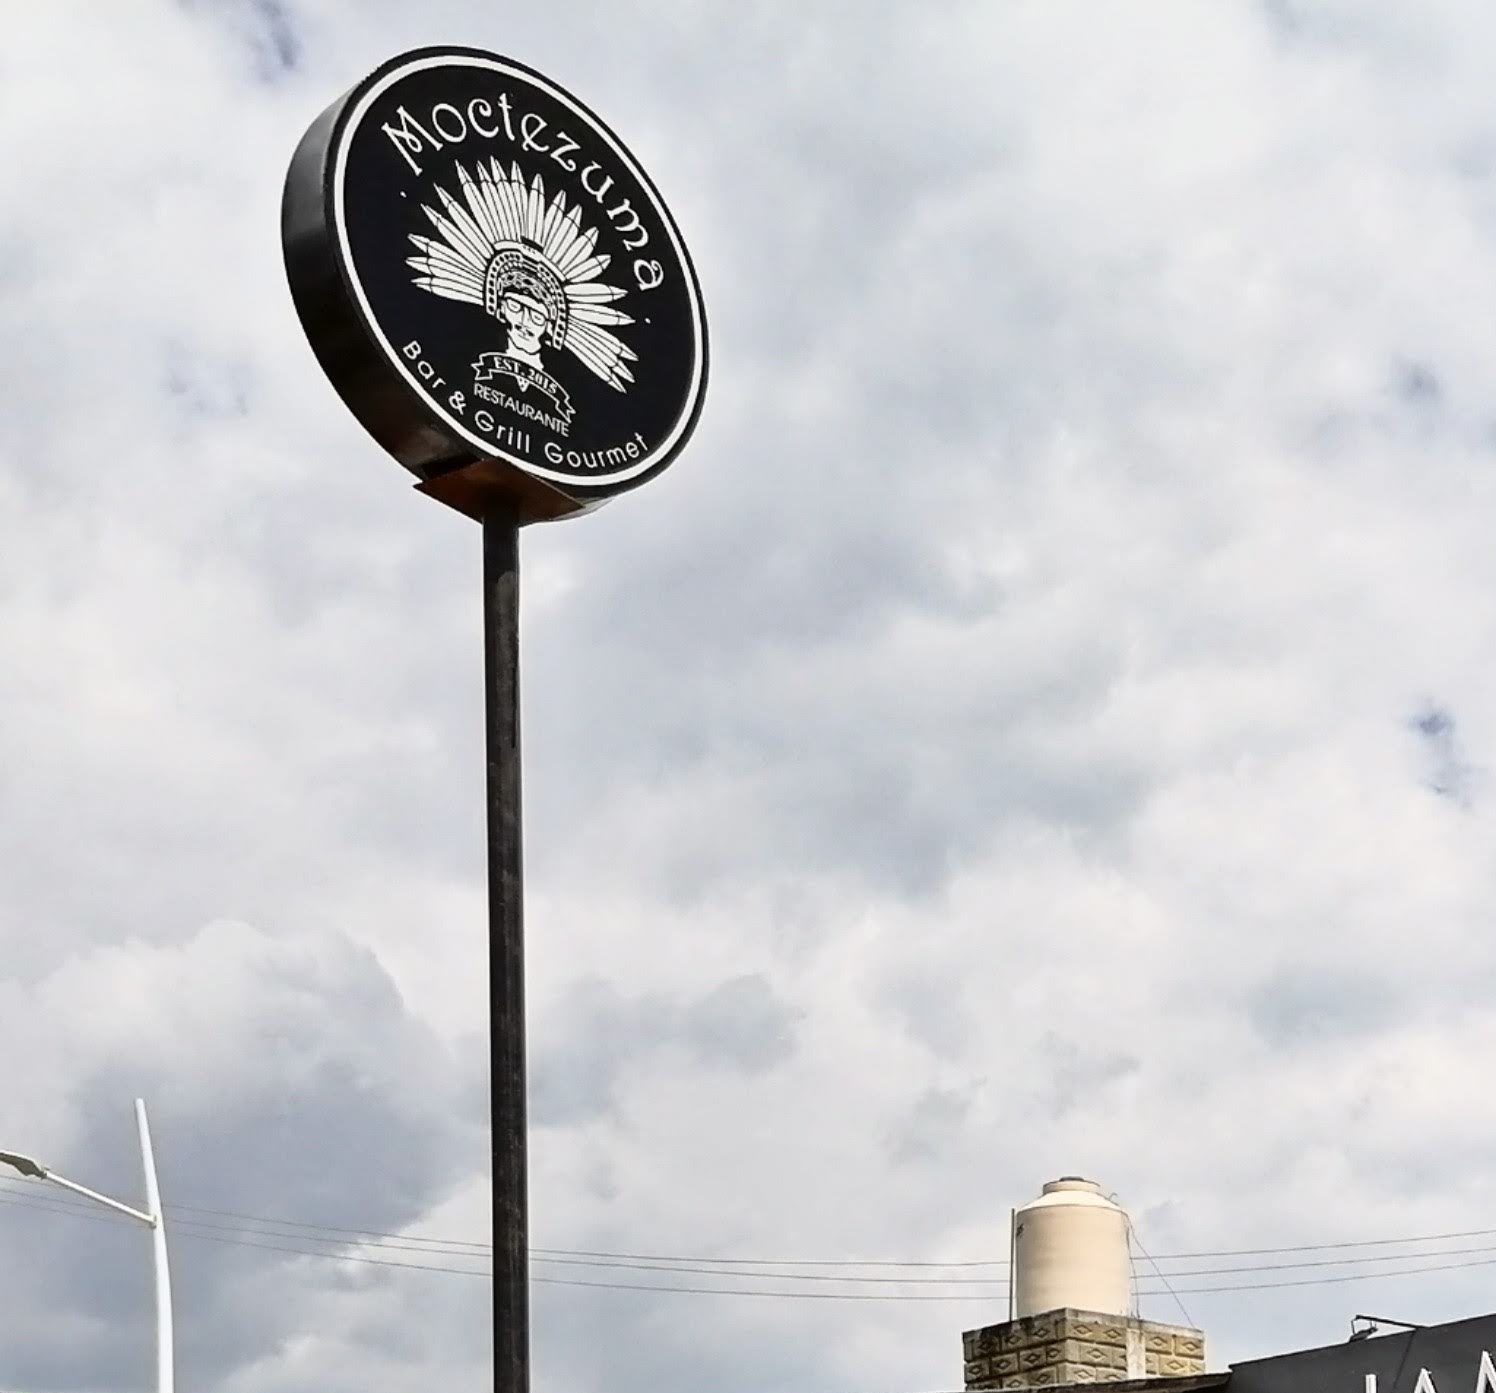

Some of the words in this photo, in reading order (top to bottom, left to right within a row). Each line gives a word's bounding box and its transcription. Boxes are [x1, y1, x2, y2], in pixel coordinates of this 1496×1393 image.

[381, 93, 664, 292] Moctezuma
[402, 340, 447, 389] Bar
[448, 390, 467, 416] &
[474, 409, 531, 454] Grill
[544, 432, 649, 469] Gourmet
[474, 382, 569, 438] RESTAURANTE
[493, 356, 526, 376] EST.
[527, 368, 557, 395] 2015
